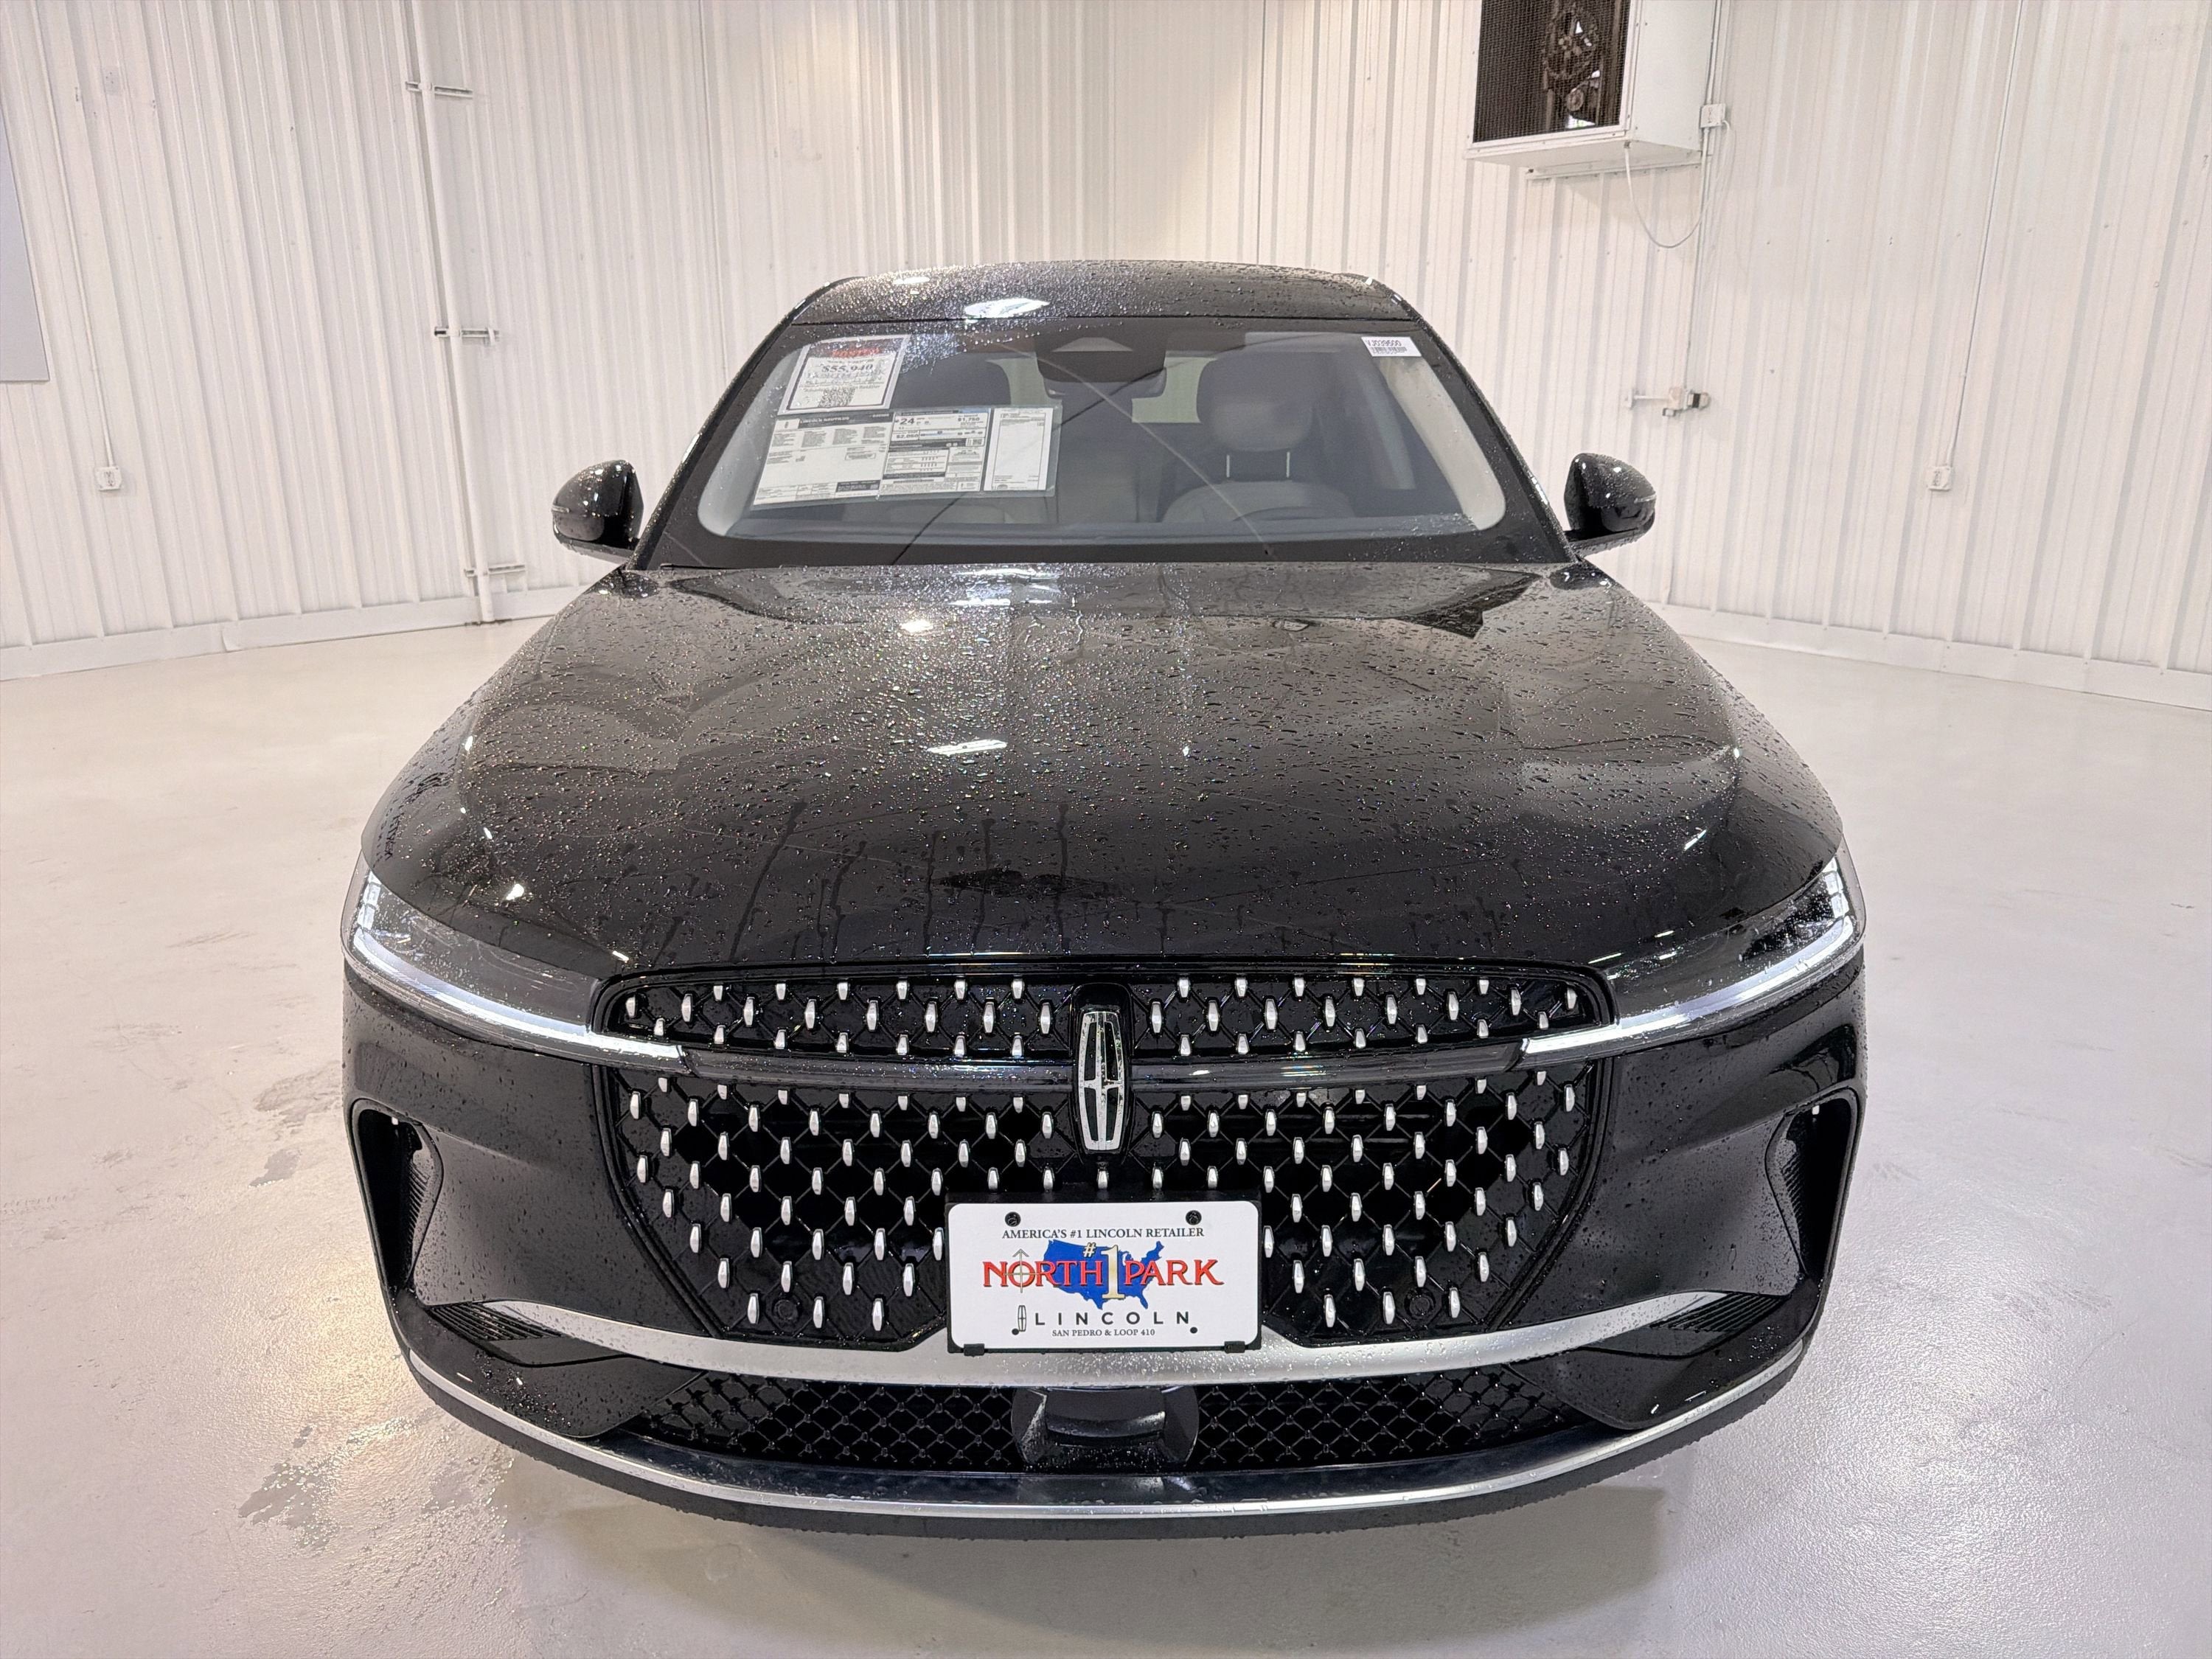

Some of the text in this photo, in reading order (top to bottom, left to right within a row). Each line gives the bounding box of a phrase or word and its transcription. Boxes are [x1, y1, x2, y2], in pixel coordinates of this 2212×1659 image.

[900, 417, 915, 425] 24
[1002, 1227, 1205, 1239] AMERICA'S #1 LINCOLN RETAILER
[983, 1259, 1225, 1287] NORTH PARK
[1035, 1311, 1189, 1326] LINCOLN
[1105, 1329, 1112, 1337] &
